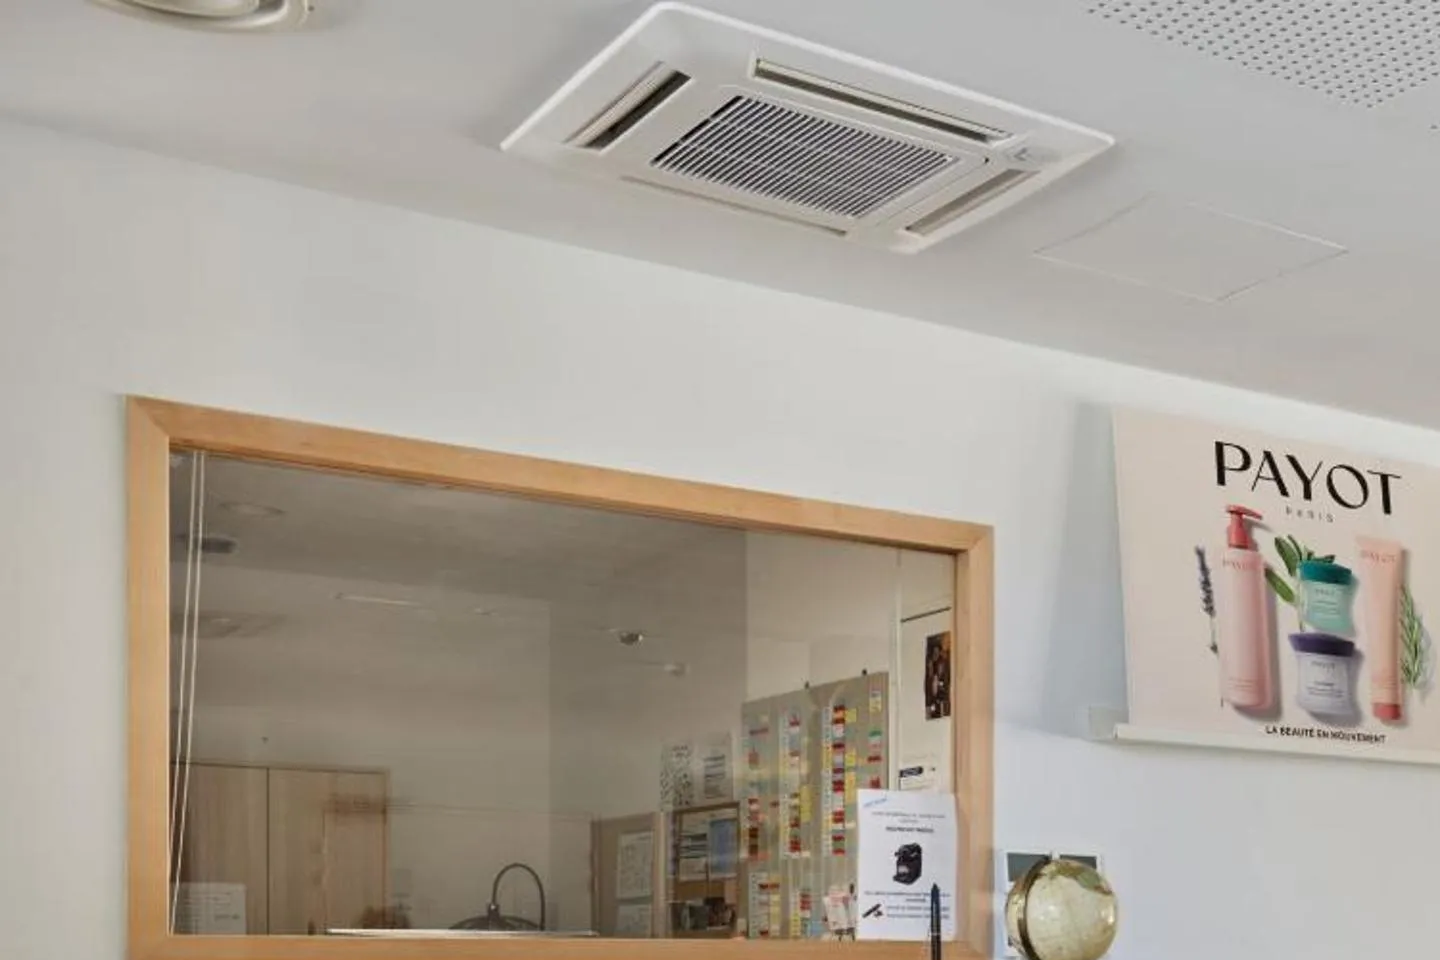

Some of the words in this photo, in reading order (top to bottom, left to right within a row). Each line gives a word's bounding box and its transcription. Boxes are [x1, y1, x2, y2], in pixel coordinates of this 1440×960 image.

[1214, 440, 1402, 515] PAYOT
[1265, 724, 1278, 735] LA
[1317, 729, 1329, 739] EN
